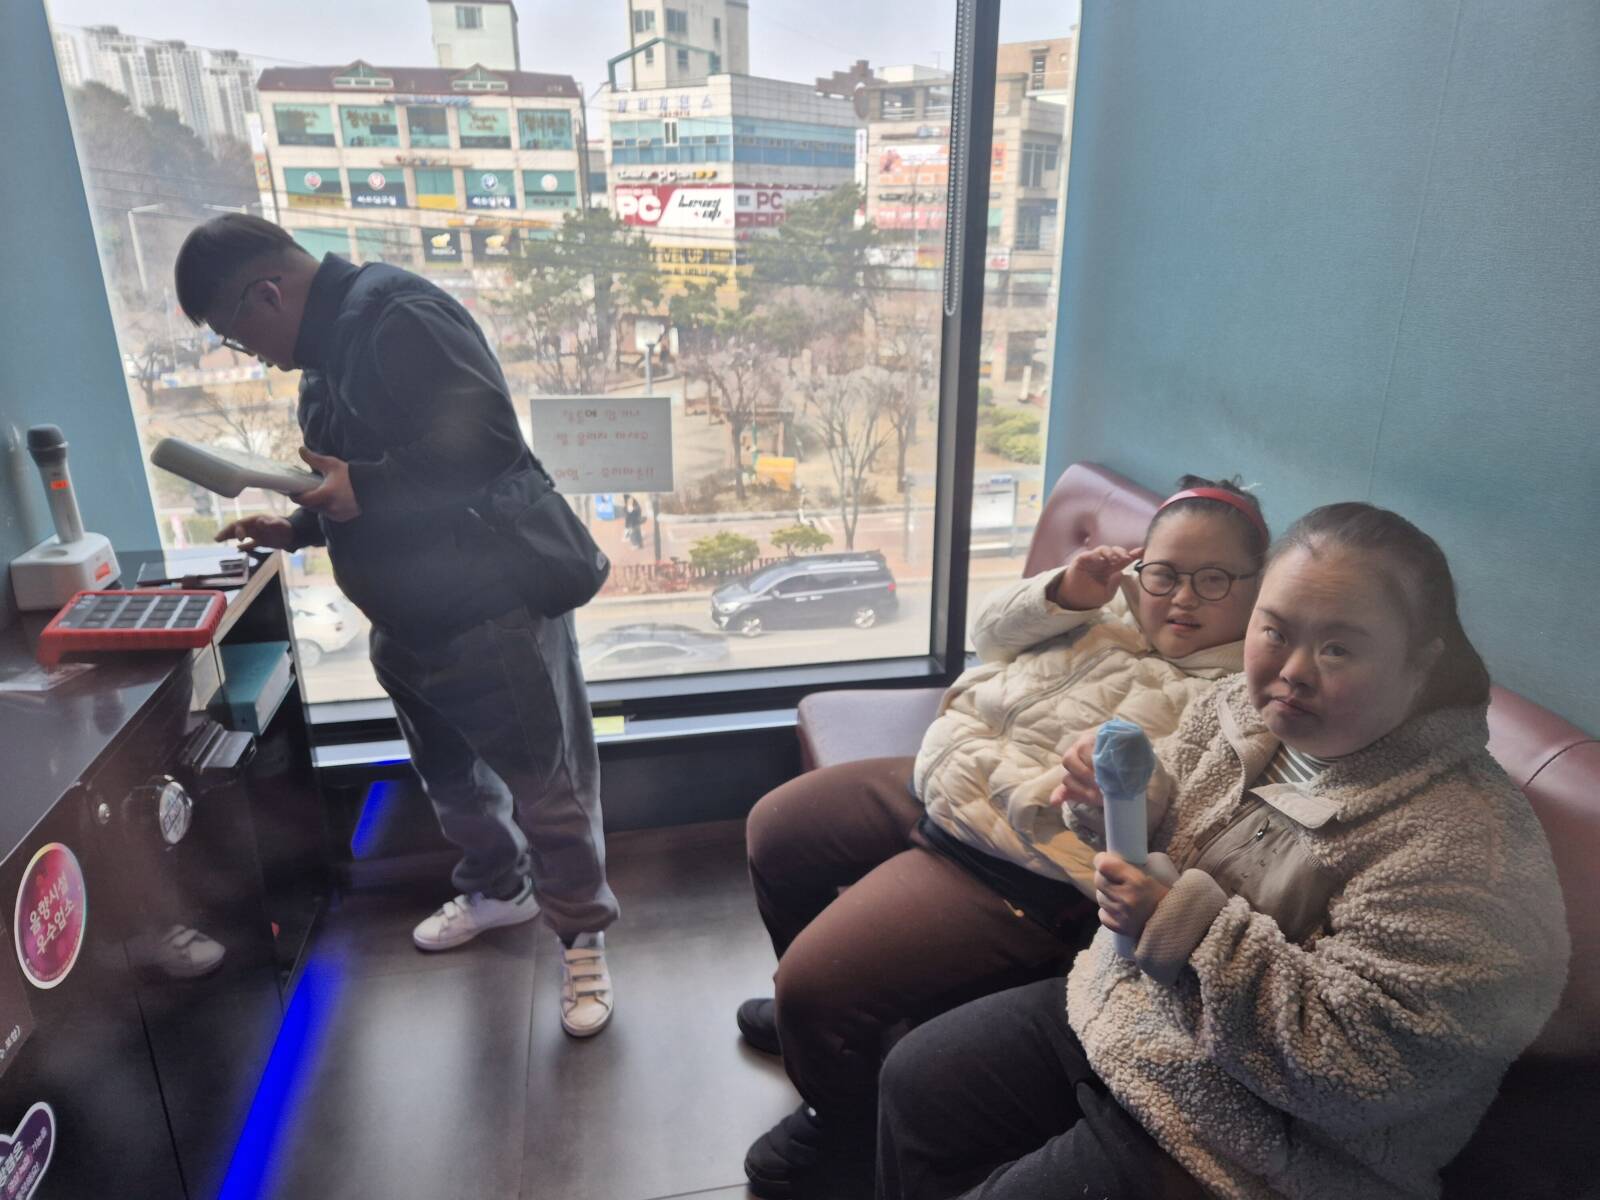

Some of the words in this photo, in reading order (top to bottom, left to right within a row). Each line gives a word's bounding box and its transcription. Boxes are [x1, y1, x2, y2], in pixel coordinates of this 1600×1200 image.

[616, 194, 662, 222] PC
[757, 191, 783, 210] PC
[30, 871, 69, 935] 음향시설
[37, 898, 74, 954] 우수업소
